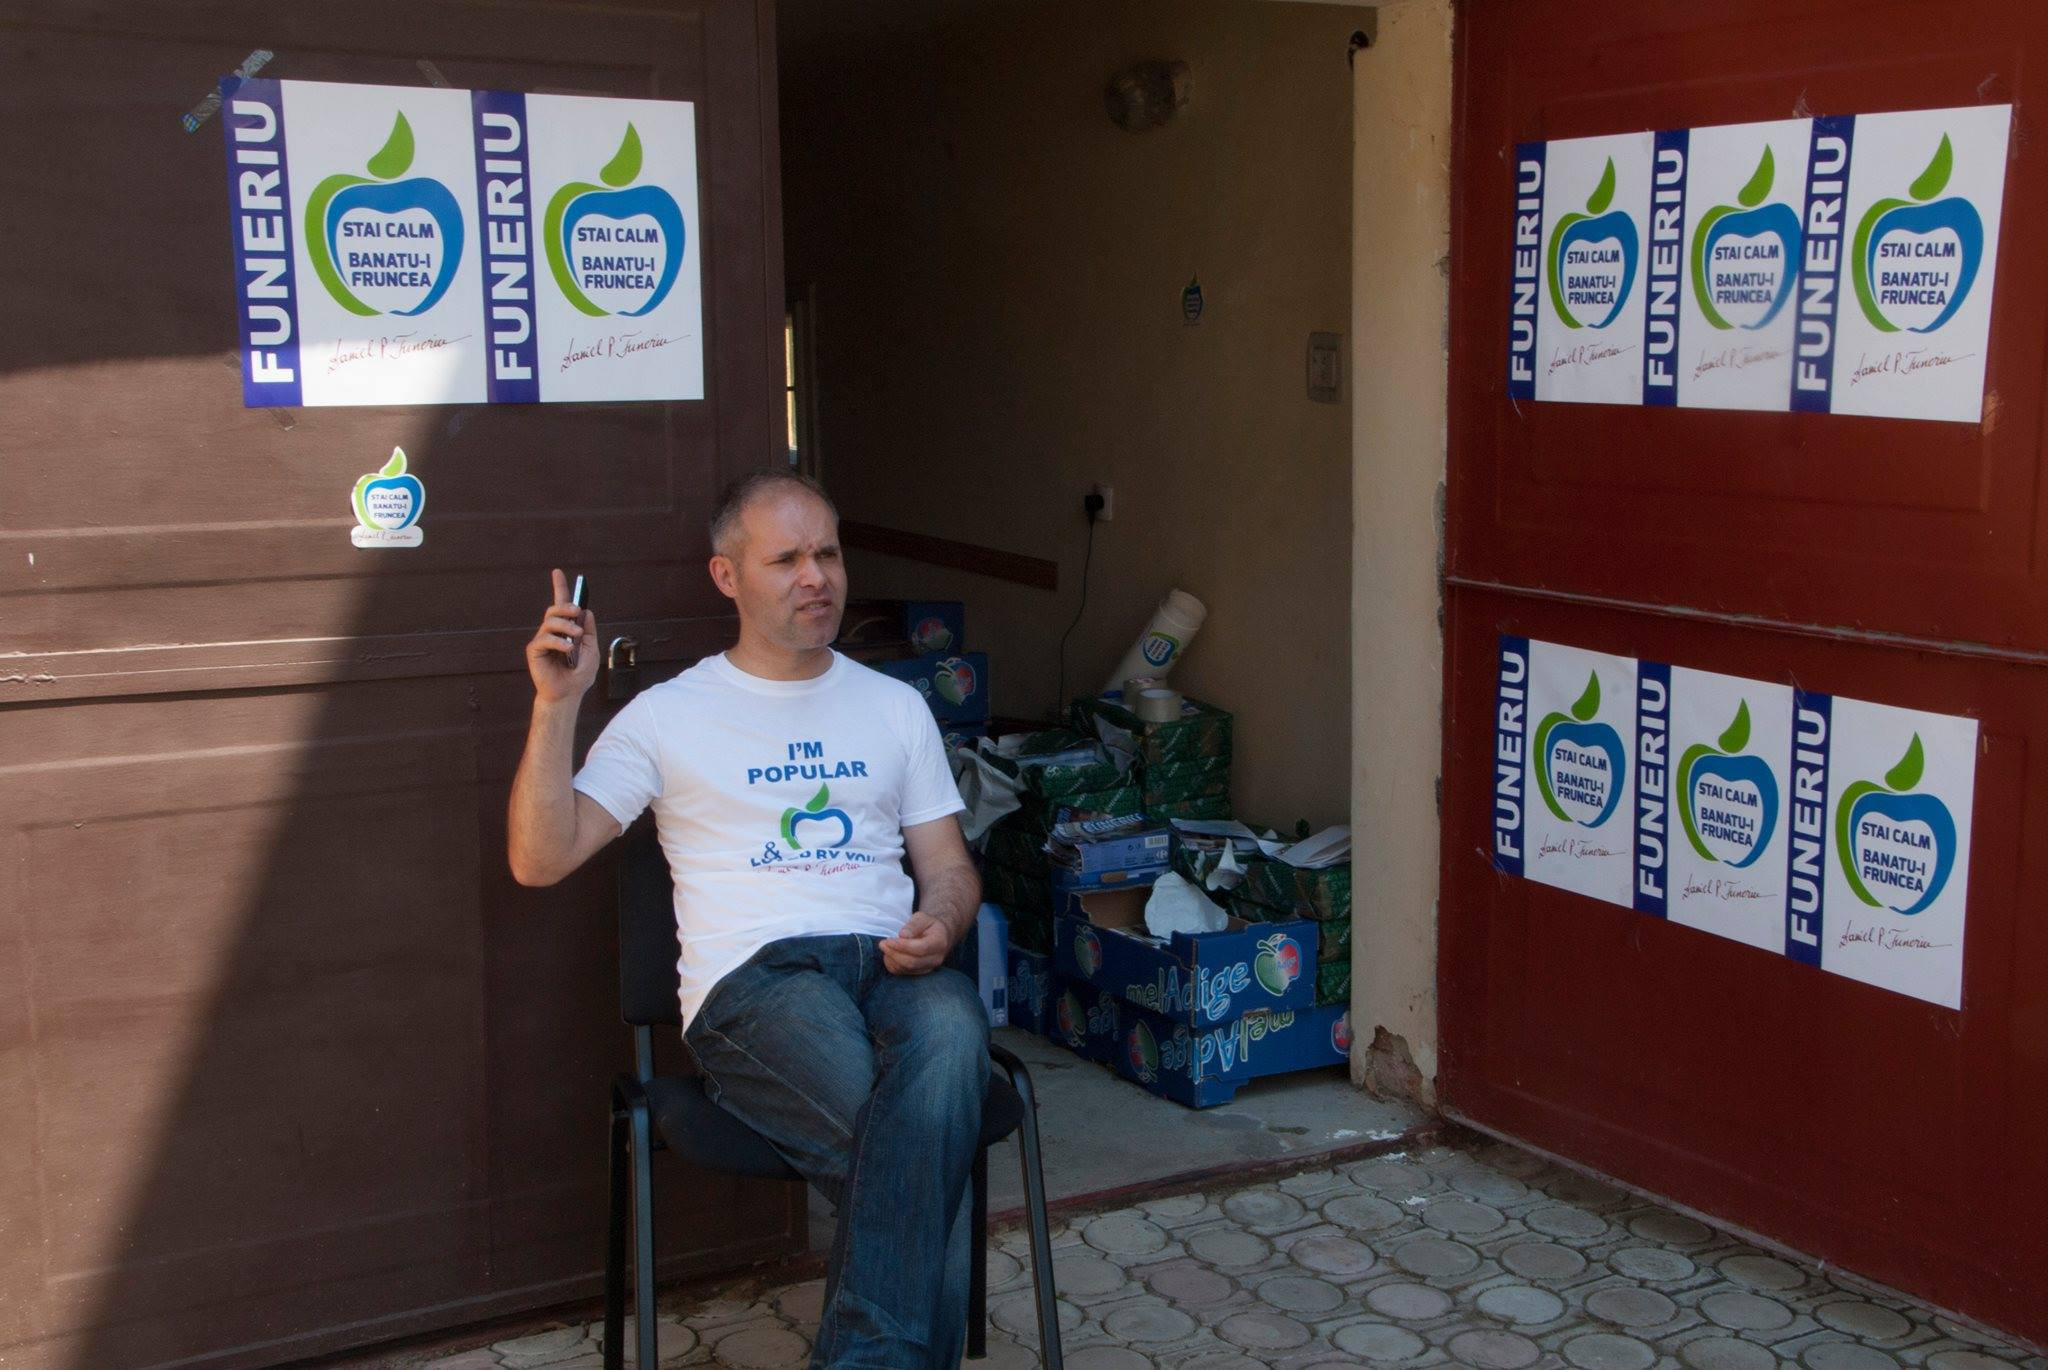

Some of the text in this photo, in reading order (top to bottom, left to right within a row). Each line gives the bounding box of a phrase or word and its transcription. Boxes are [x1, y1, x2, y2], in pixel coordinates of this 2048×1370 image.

[343, 222, 434, 238] STAI CALM
[577, 227, 659, 243] STAI CALM
[233, 101, 294, 384] FUNERIU
[483, 112, 532, 380] FUNERIU
[1715, 245, 1779, 260] STAI CALM
[1880, 242, 1956, 258] STAI CALM
[349, 252, 431, 268] BANATU-I
[582, 256, 655, 272] BANATU-I
[1567, 250, 1620, 264] STAI CALM
[1649, 149, 1684, 387] FUNERIU
[1798, 136, 1847, 391] FUNERIU
[352, 271, 432, 287] FRUNCEA
[584, 274, 656, 289] FRUNCEA
[1512, 160, 1541, 381] FUNERIU
[1716, 272, 1775, 287] BANATU-I
[1881, 272, 1949, 288] BANATU-I
[1568, 276, 1616, 289] BANATU-I
[1568, 291, 1615, 304] FRUNCEA
[1716, 290, 1772, 304] FRUNCEA
[1881, 290, 1946, 305] FRUNCEA
[788, 742, 823, 760] I'M
[1497, 651, 1525, 859] FUNERIU
[1555, 748, 1607, 772] STAI CALM
[748, 761, 868, 784] POPULAR
[1557, 771, 1604, 794] BANATU-I
[1557, 786, 1604, 808] FRUNCEA
[1640, 678, 1667, 899] FUNERIU
[1699, 782, 1757, 808] STAI CALM
[1701, 807, 1753, 832] BANATU-I
[1791, 708, 1826, 947] FUNERIU
[1701, 823, 1752, 848] FRUNCEA
[1862, 821, 1931, 850] STAI CALM
[1863, 848, 1926, 876] BANATU-I
[1864, 866, 1924, 892] FRUNCEA
